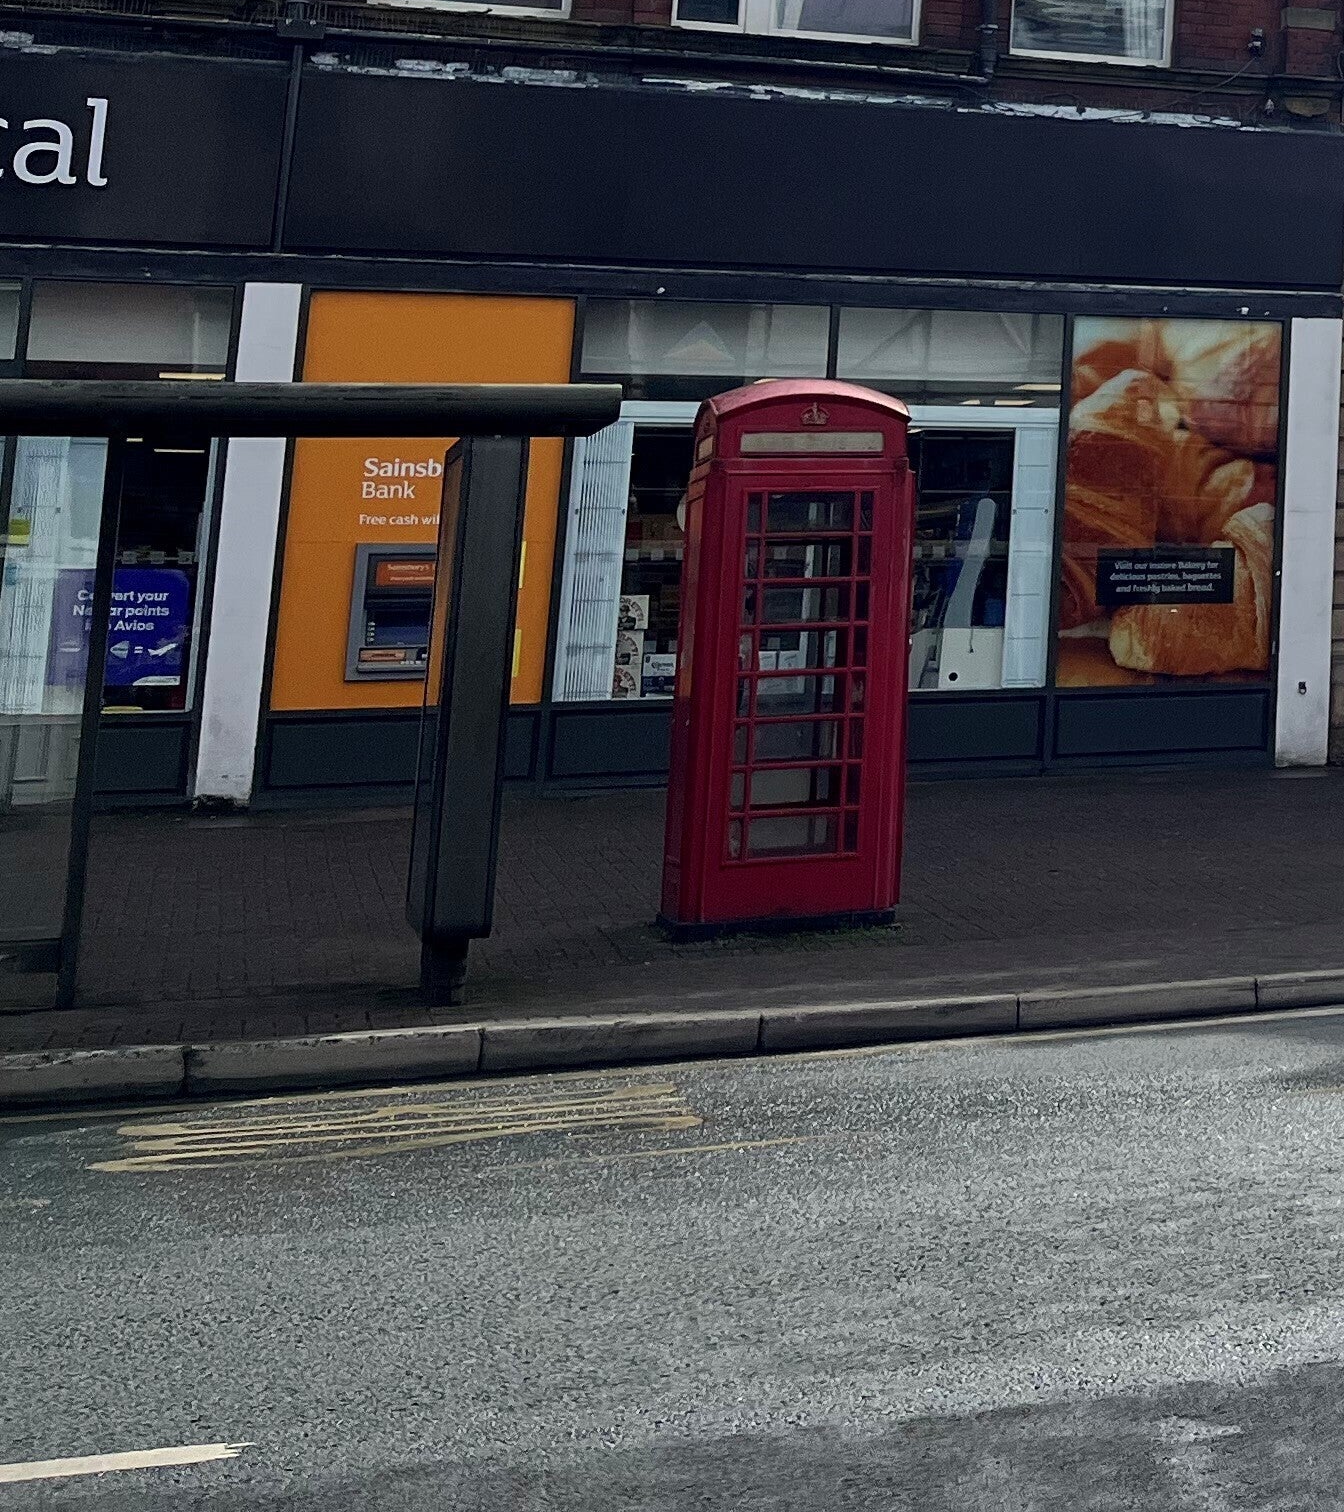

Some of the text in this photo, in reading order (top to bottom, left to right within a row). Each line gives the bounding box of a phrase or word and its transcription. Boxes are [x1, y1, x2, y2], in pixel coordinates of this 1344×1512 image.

[0, 96, 109, 187] al
[361, 480, 416, 499] Bank
[359, 513, 387, 525] Free
[389, 513, 419, 525] cash
[137, 591, 170, 604] your
[125, 604, 170, 618] points
[113, 620, 155, 631] Avios
